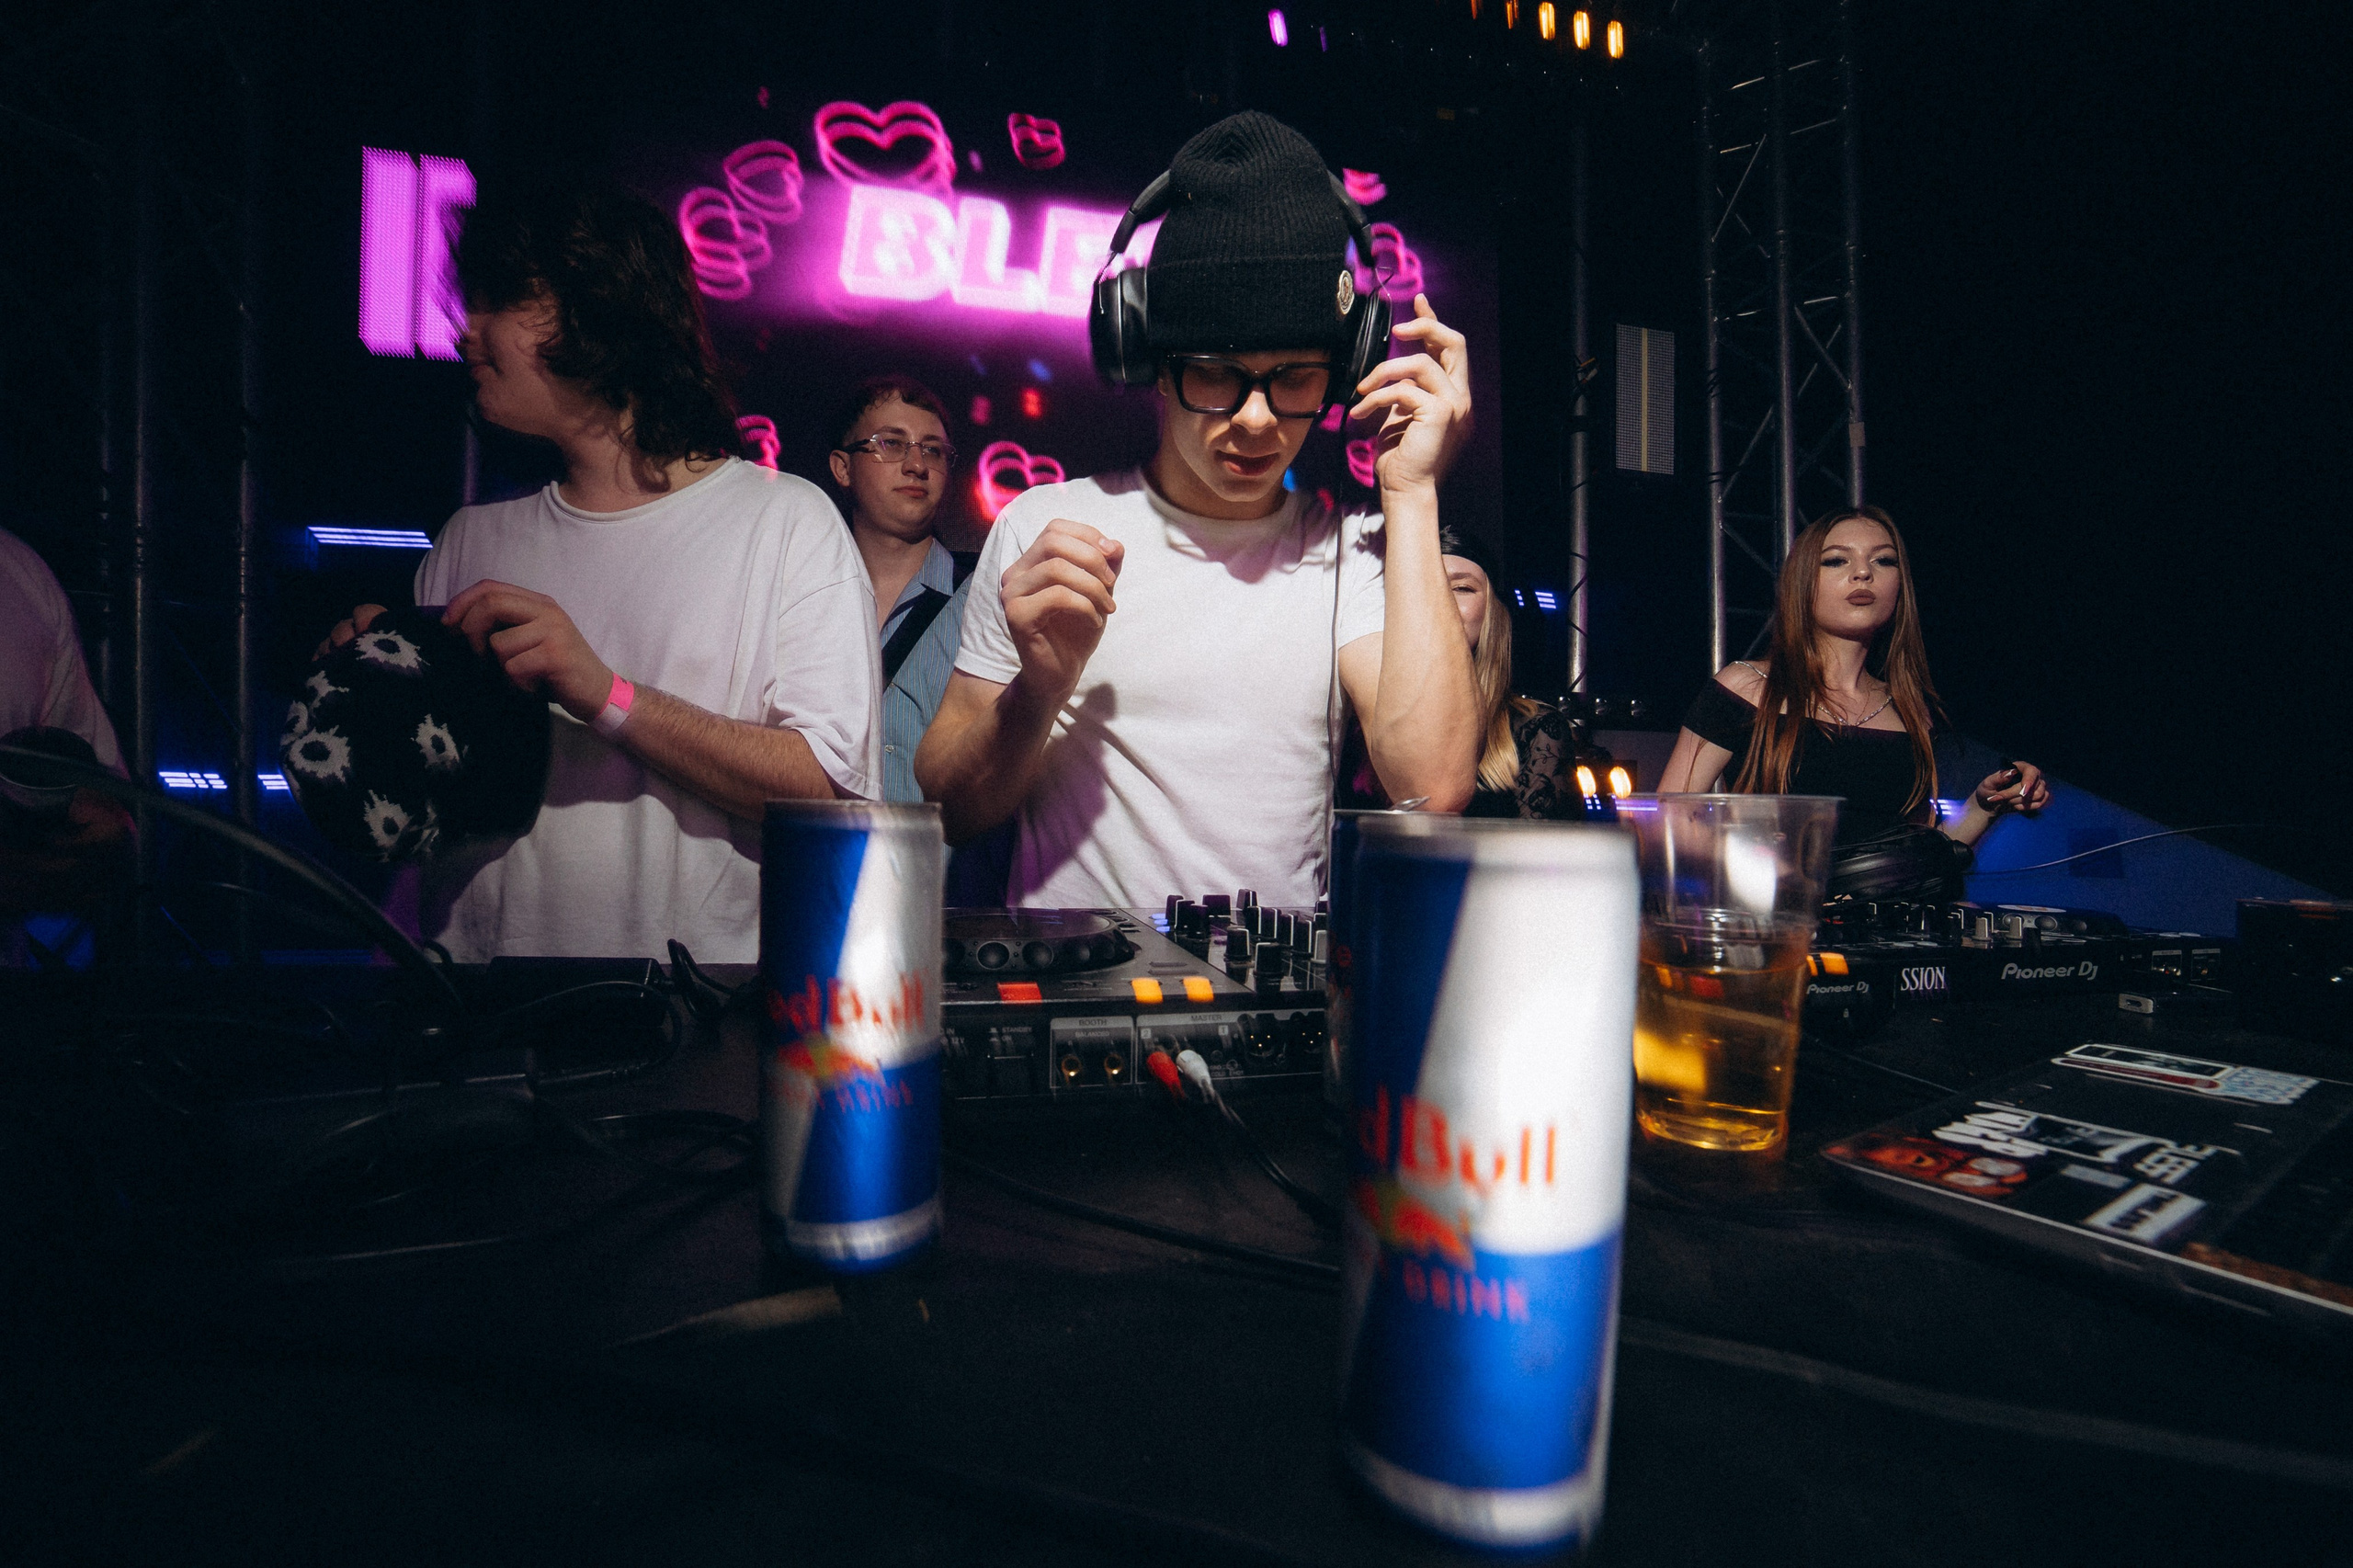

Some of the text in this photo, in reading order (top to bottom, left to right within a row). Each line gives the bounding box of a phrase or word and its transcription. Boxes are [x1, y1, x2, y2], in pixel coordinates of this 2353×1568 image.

[838, 184, 1158, 320] BLE
[1900, 966, 1946, 992] SSION
[2001, 960, 2098, 981] Pioneer DJ
[1806, 983, 1855, 994] Pioneer
[1078, 1018, 1108, 1027] BOOTH
[1191, 1014, 1222, 1023] MASTER
[1399, 1092, 1556, 1202] Bull
[1402, 1257, 1531, 1325] DRINK
